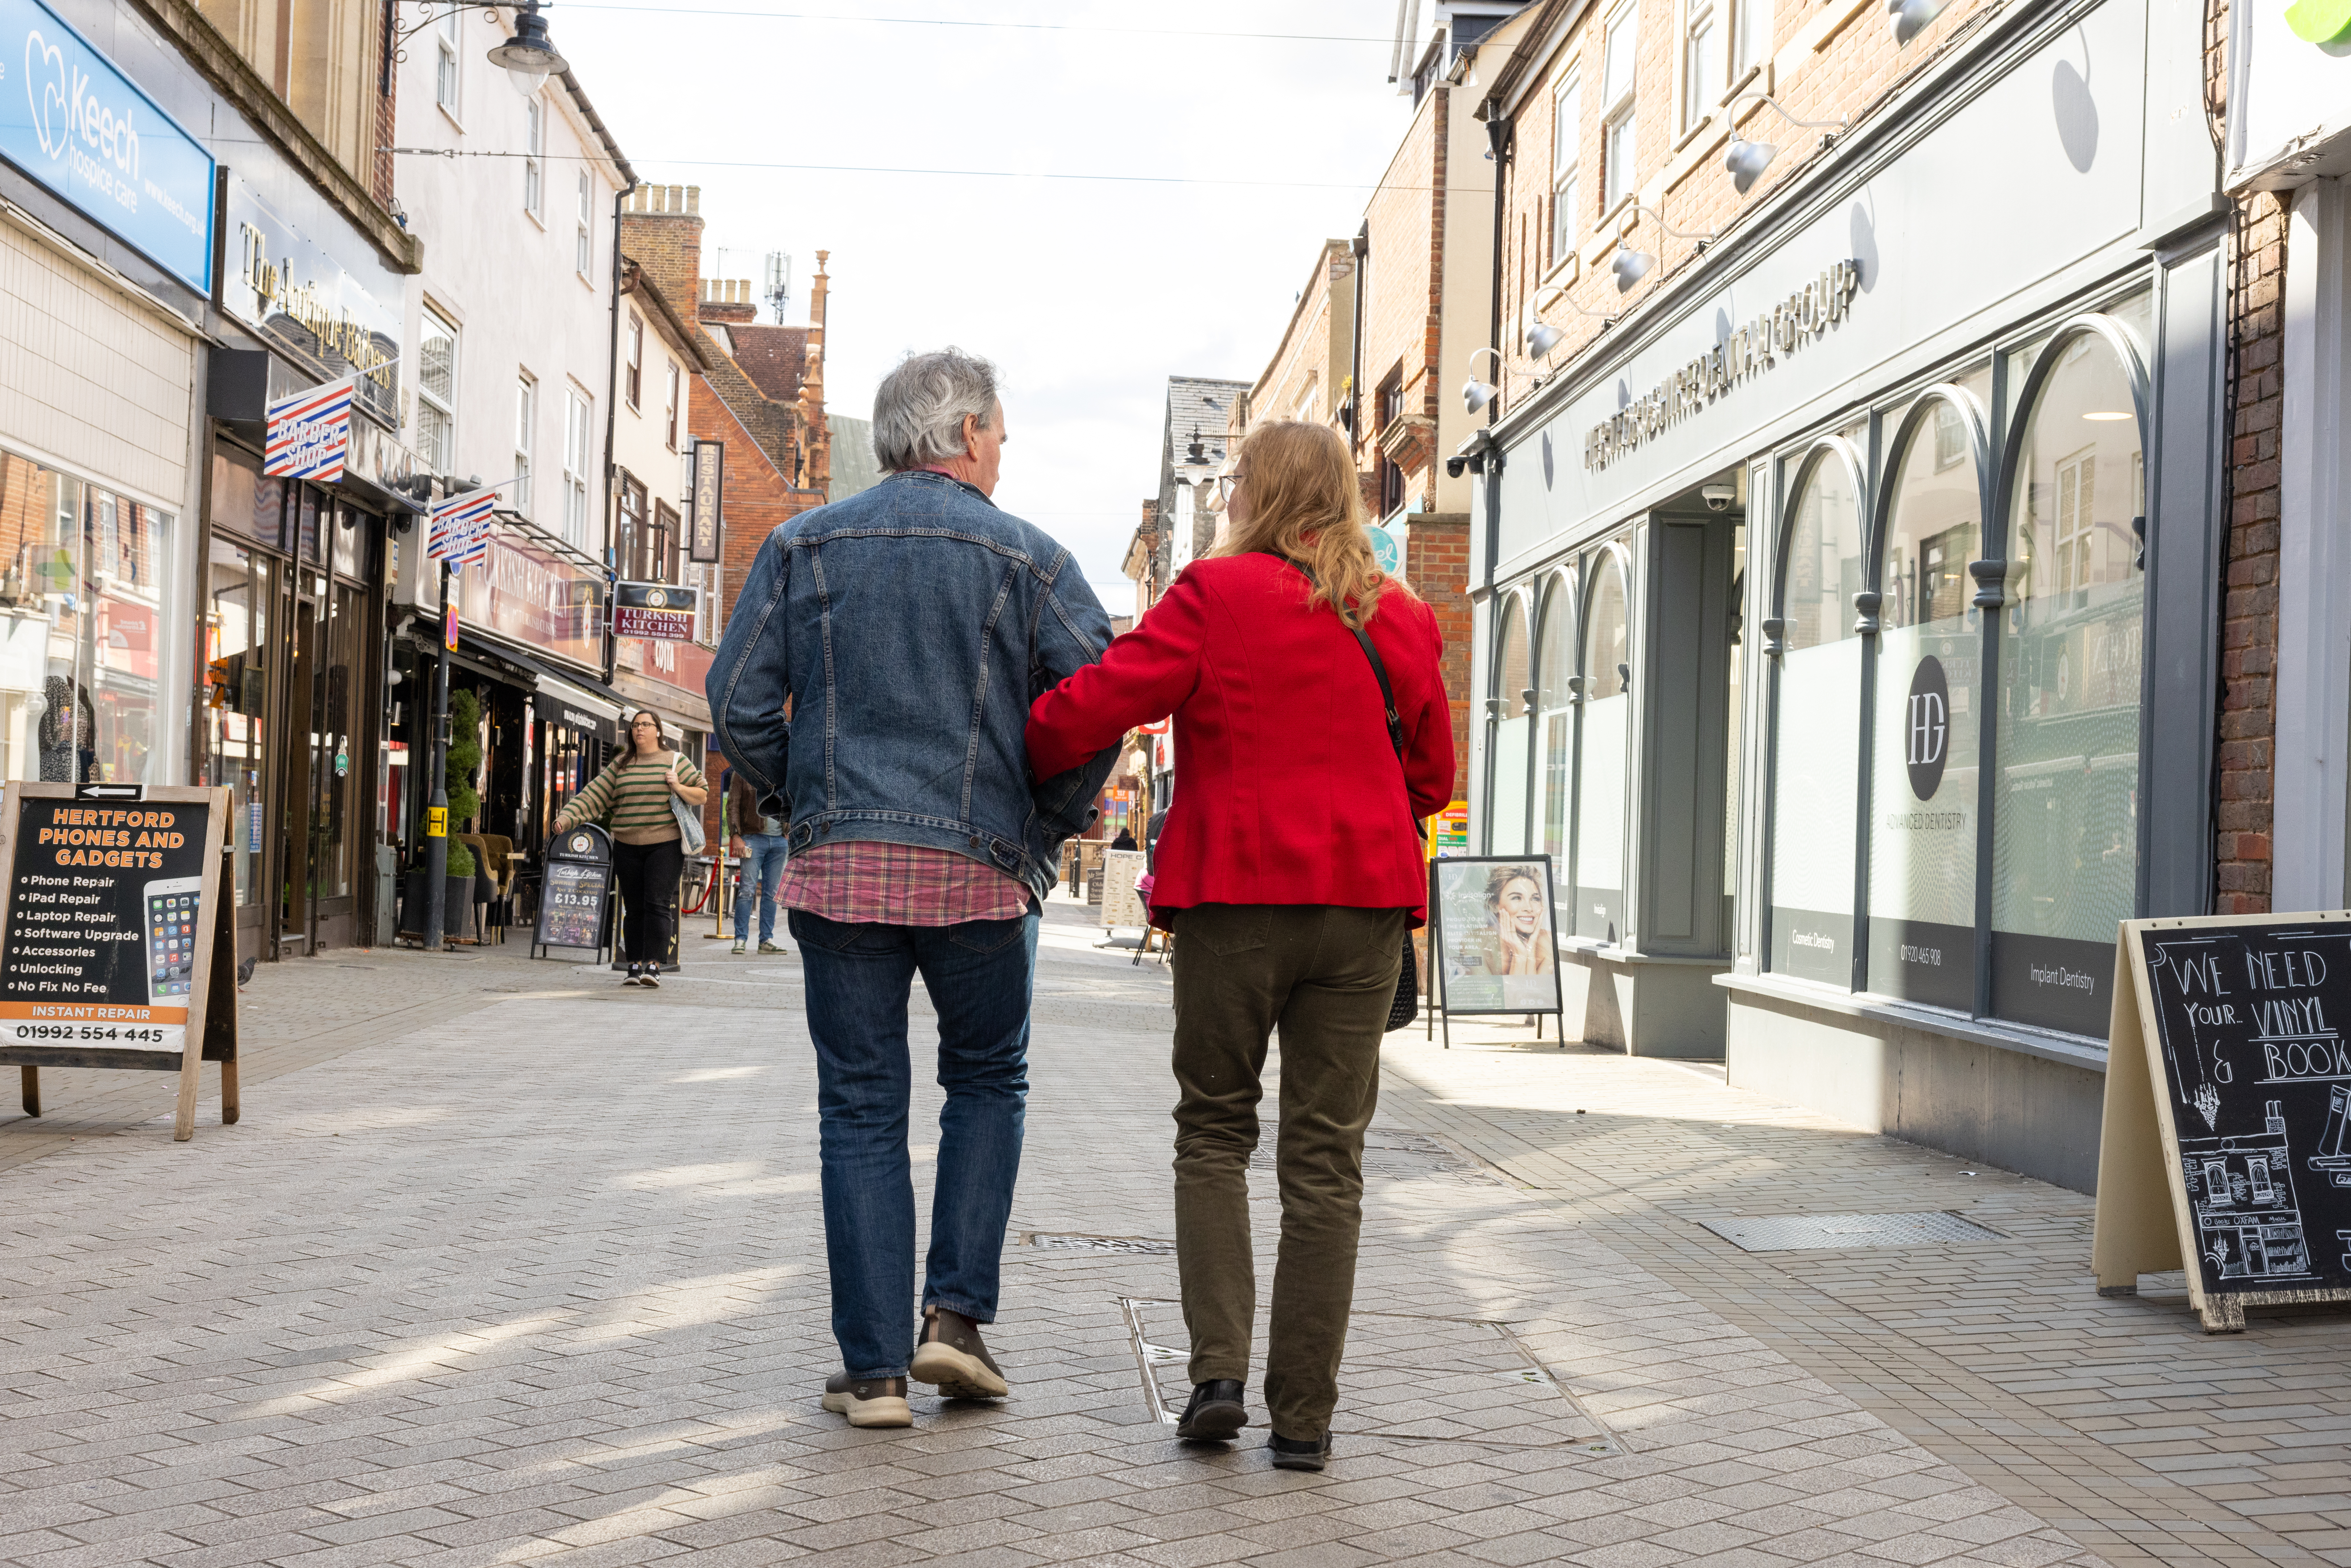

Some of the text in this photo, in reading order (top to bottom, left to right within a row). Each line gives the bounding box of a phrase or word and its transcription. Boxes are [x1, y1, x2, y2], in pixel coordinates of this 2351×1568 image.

[71, 64, 139, 181] Keech
[69, 135, 137, 214] hospice care
[145, 177, 206, 239] www.keech.org.uk
[246, 221, 390, 390] The Antique Barbers
[1585, 258, 1857, 469] HERTFORDSHIRE DENTAL GROUP
[277, 418, 339, 446] BARBER
[285, 444, 327, 468] SHOP
[698, 444, 715, 546] RESTAURANT
[437, 516, 484, 539] BARBER
[440, 535, 473, 555] SHOP
[483, 541, 525, 599] URKISH
[623, 608, 687, 622] TURKISH
[621, 618, 687, 633] KITCHEN
[53, 809, 175, 828] HERTFORD
[1886, 813, 1966, 829] ADVANCED DENTISTRY
[39, 828, 184, 849] PHONES AND
[55, 849, 163, 869] GADGETS
[31, 876, 115, 888] Phone Repair
[557, 867, 602, 878] Turkish Kitchen
[29, 893, 101, 906] iPad Repair
[555, 893, 598, 906] £13.95
[1459, 891, 1491, 900] invisalign
[26, 911, 116, 924] Laptop Repair
[24, 928, 139, 942] Software Upgrade
[1793, 930, 1834, 954] Cosmetic Dentistry
[22, 946, 95, 958] Accessories
[1901, 944, 1941, 966] 01920 465 908
[20, 963, 82, 977] Unlocking
[2031, 963, 2094, 995] Implant Dentistry
[2169, 951, 2326, 997] WE NEED
[18, 982, 107, 993] No Fix No Fee
[32, 1006, 151, 1020] INSTANT REPAIR
[2251, 997, 2336, 1036] VINYL
[16, 1026, 163, 1042] 01992 554 445
[2214, 1040, 2351, 1083] & BOOK
[2234, 1216, 2260, 1225] OXFAM
